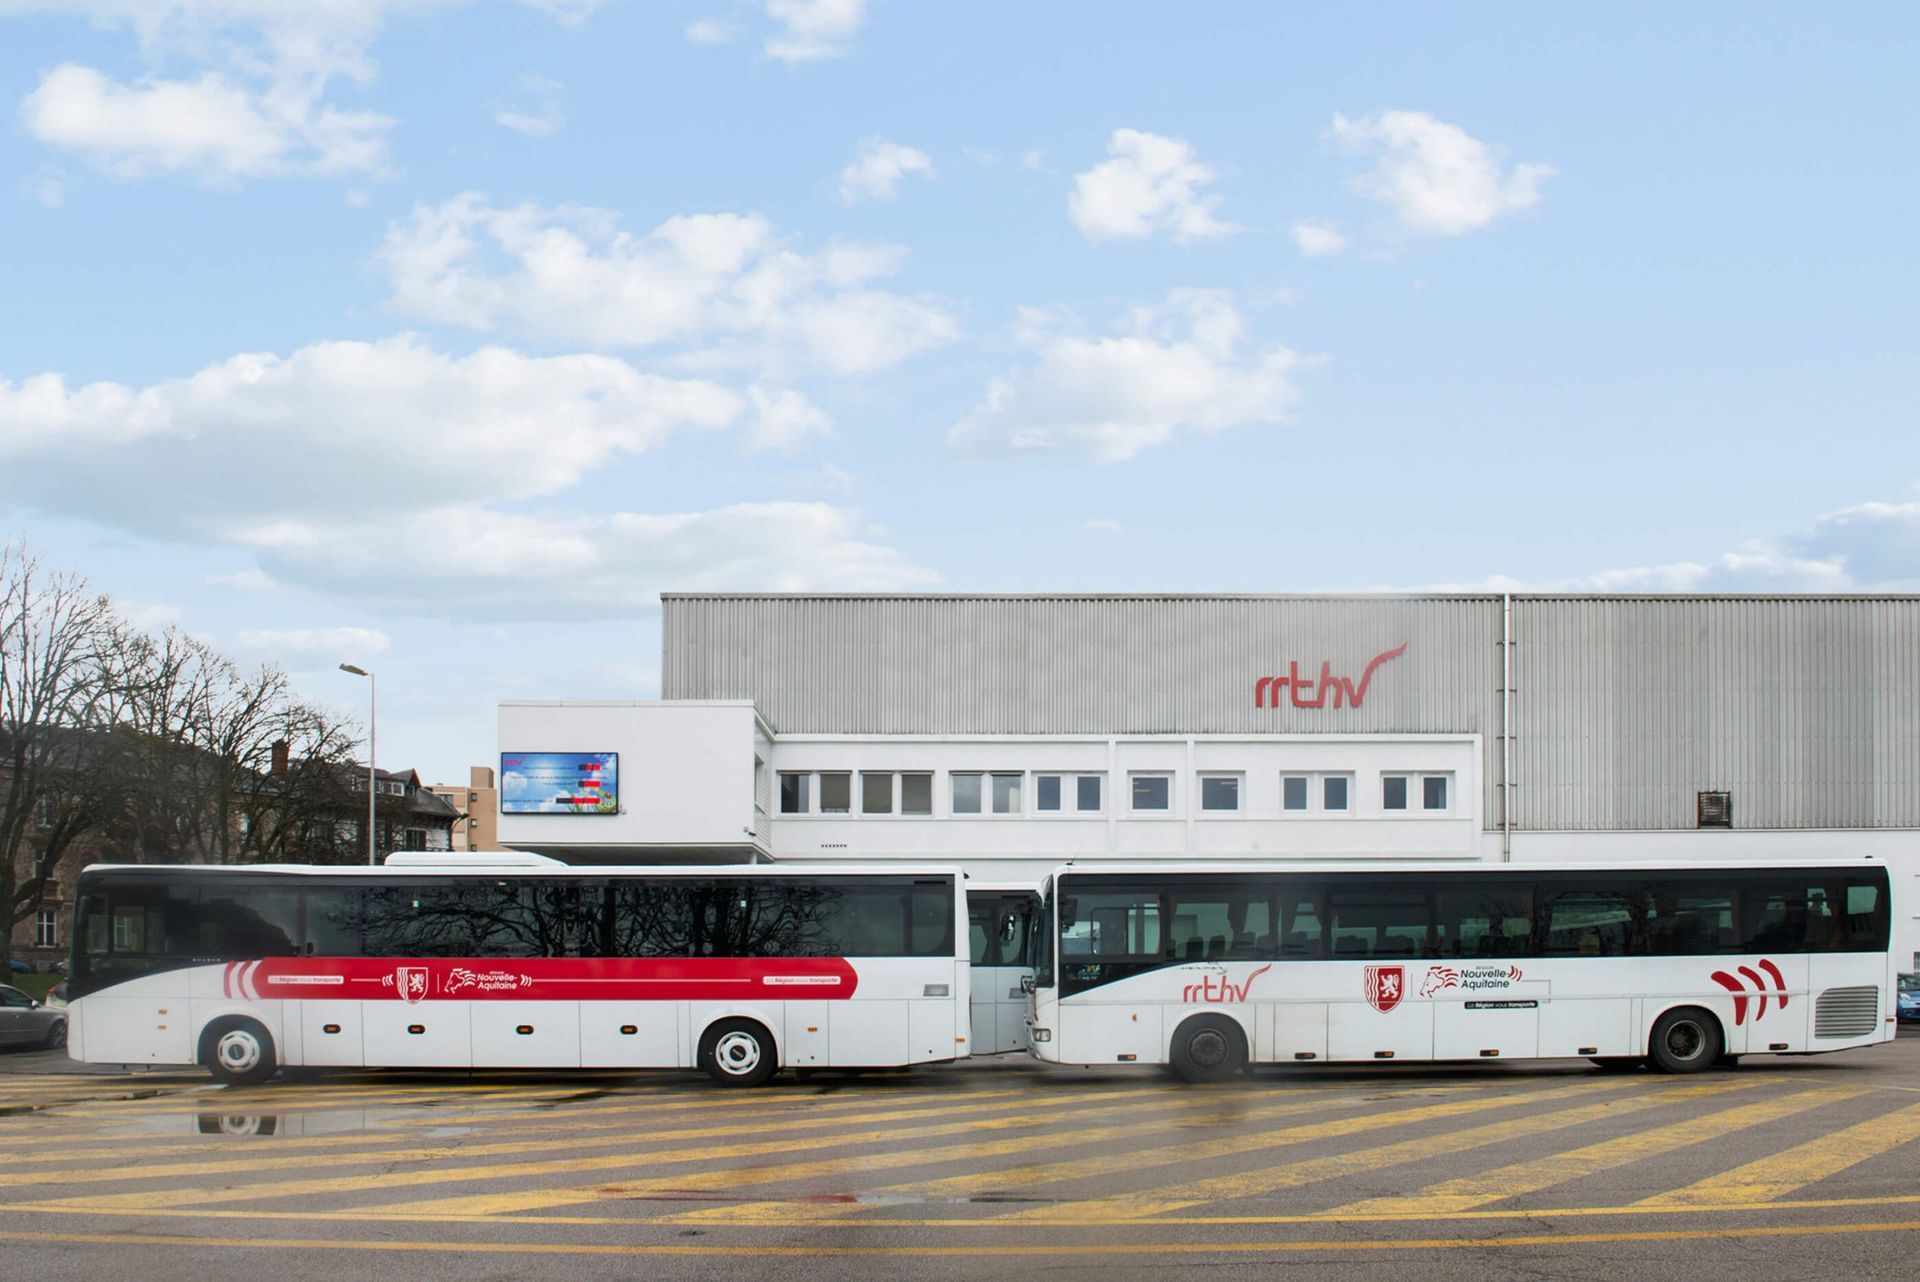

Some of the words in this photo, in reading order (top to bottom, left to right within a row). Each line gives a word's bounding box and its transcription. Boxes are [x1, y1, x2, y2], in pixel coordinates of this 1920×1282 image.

[1255, 640, 1408, 709] rrthv
[477, 981, 517, 991] Aquitaine
[1183, 963, 1272, 1003] rrthv
[1461, 979, 1510, 991] Aquitaine
